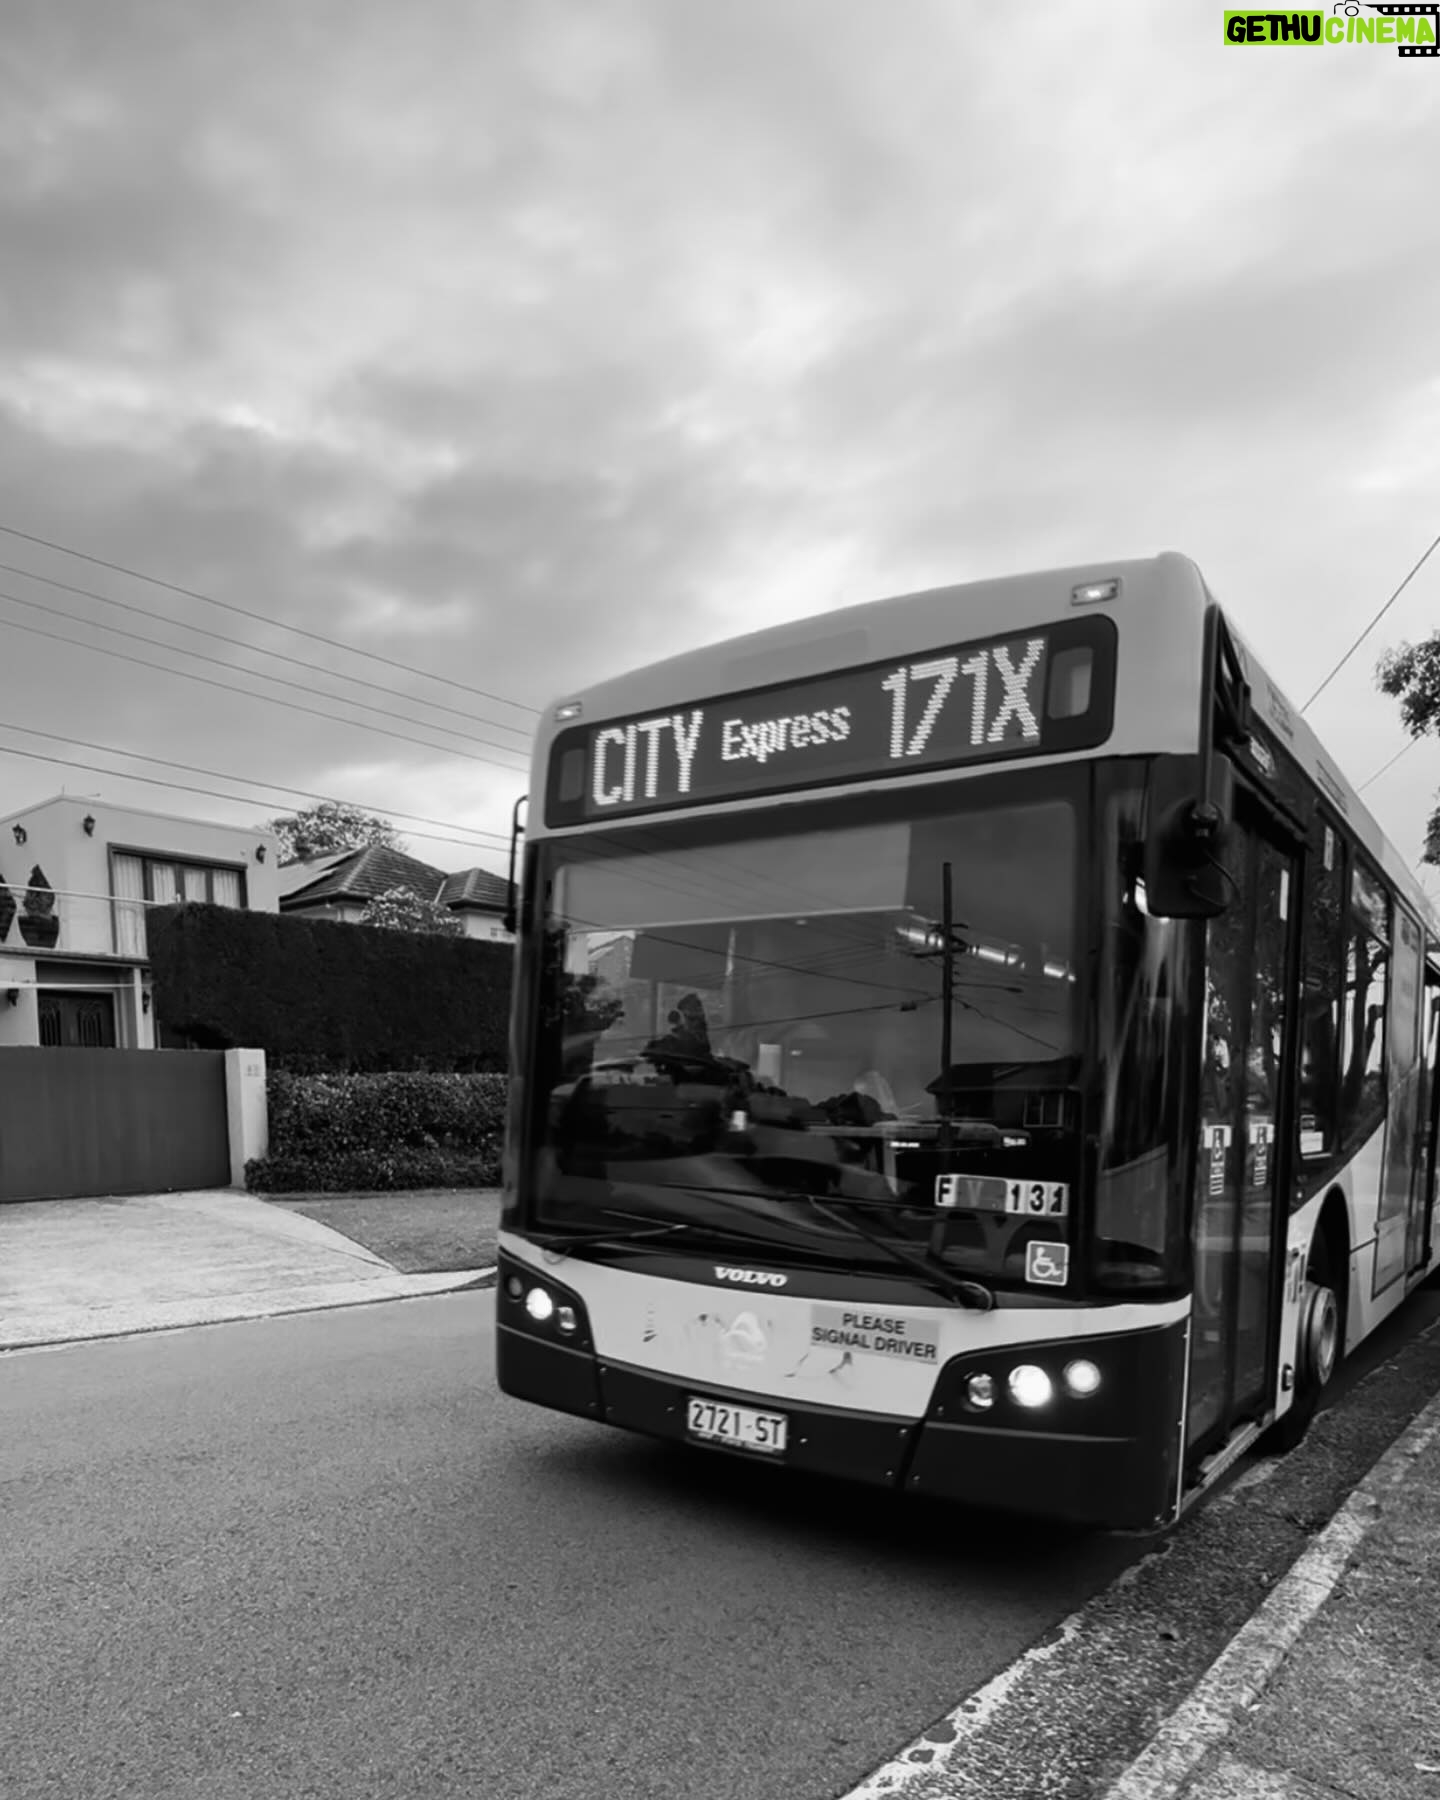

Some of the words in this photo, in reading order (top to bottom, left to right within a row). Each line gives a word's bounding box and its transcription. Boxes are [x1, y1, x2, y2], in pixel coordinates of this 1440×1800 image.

[592, 710, 704, 806] CITY
[721, 706, 851, 764] Express
[881, 639, 1045, 758] 171X
[713, 1265, 789, 1287] VOLVO
[842, 1312, 906, 1336] PLEASE
[811, 1327, 871, 1350] SIGNAL
[874, 1336, 937, 1360] DRIVER
